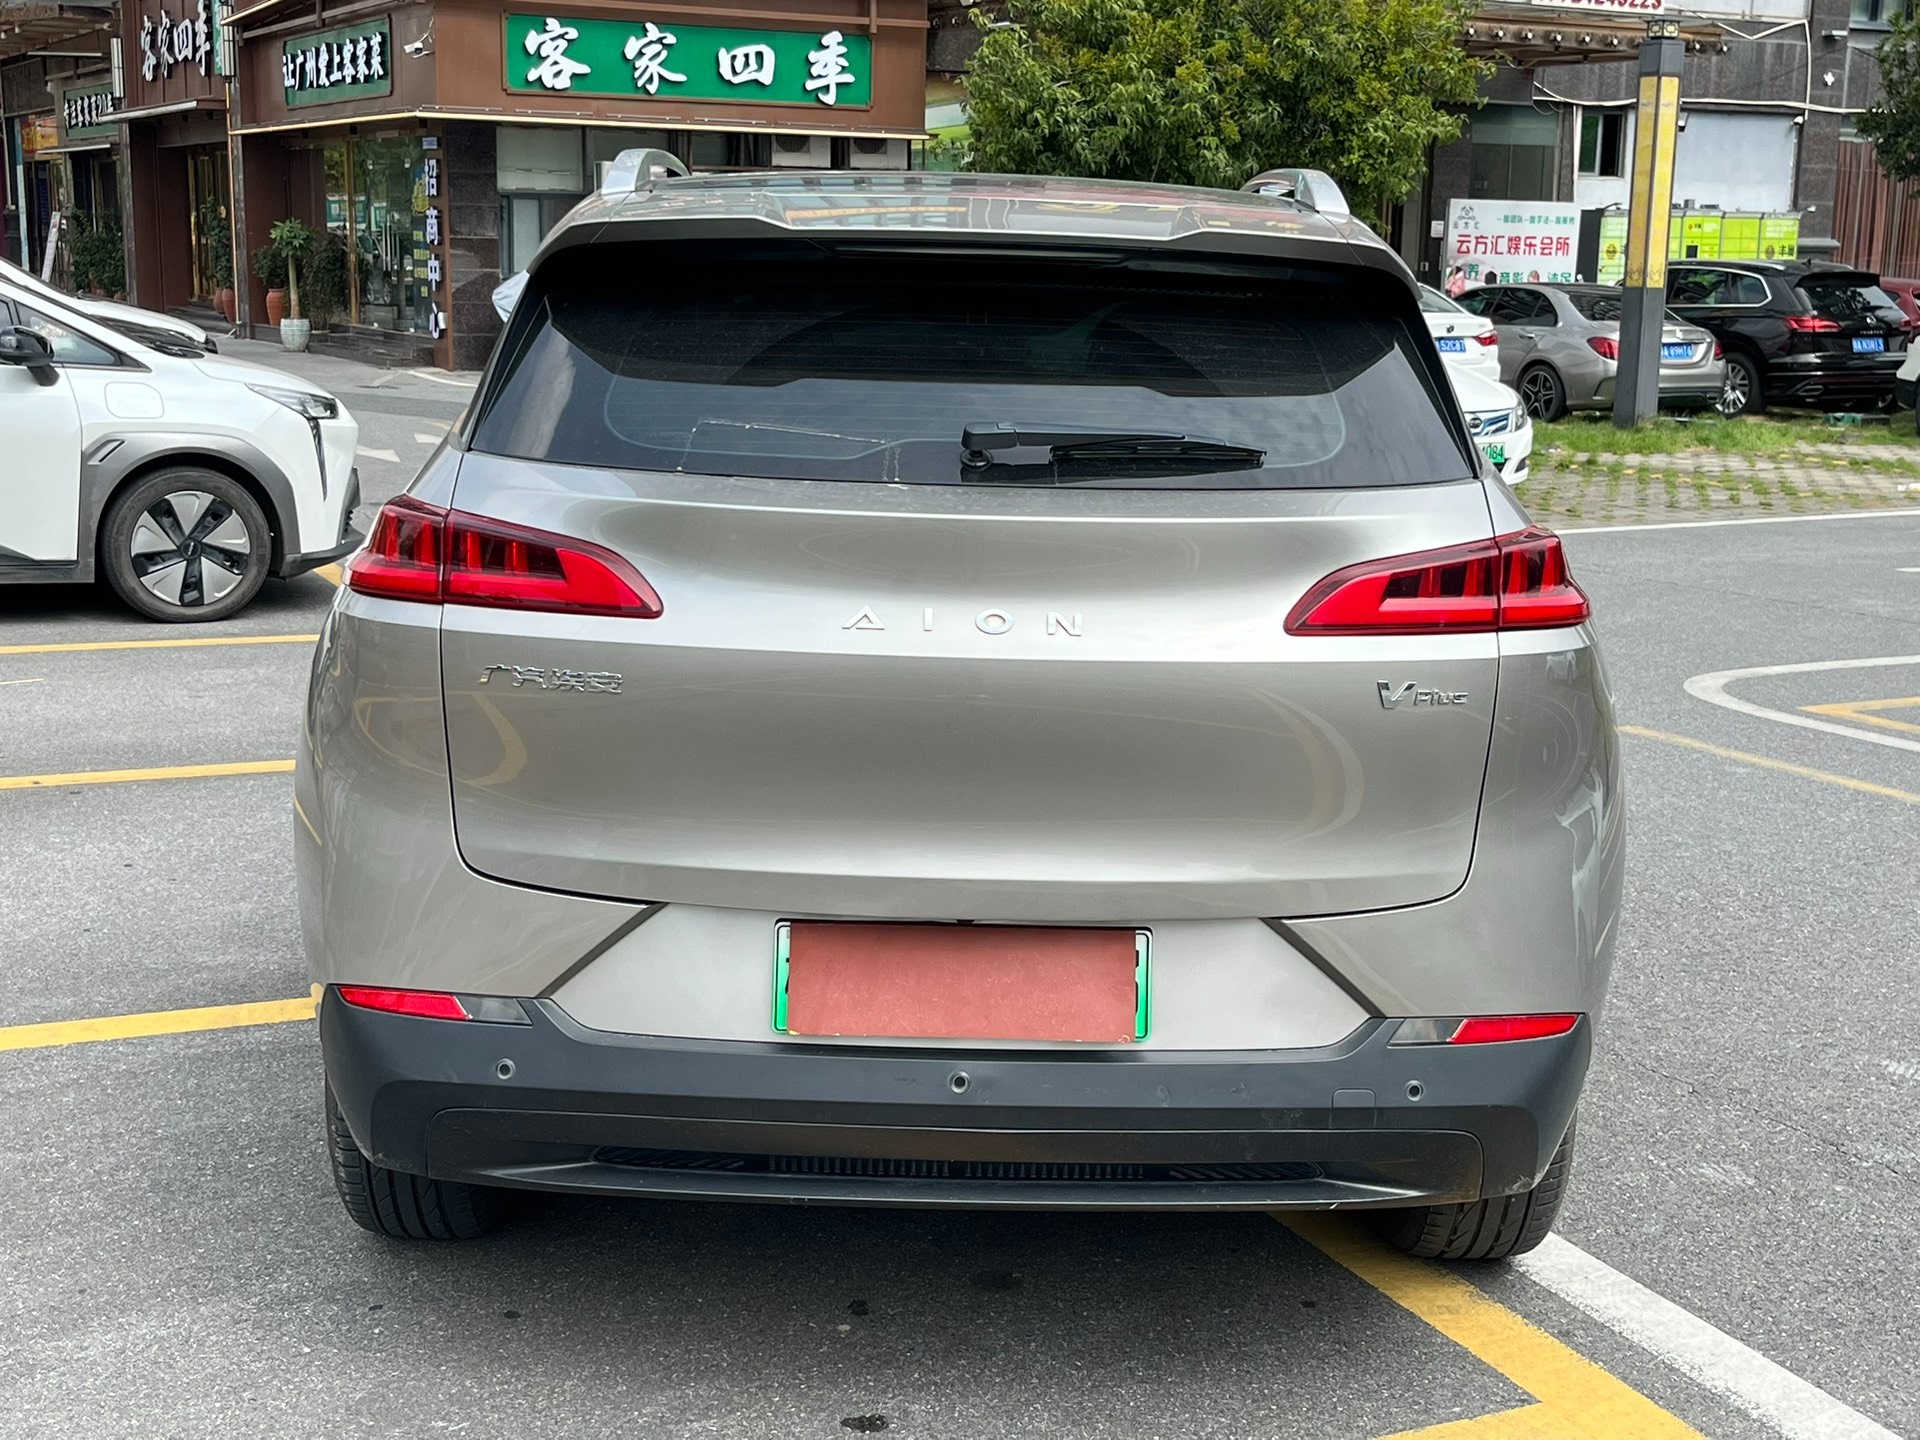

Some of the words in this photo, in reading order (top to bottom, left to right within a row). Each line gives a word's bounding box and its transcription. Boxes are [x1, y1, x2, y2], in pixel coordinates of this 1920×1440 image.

[141, 0, 211, 82] 客家四季
[283, 32, 384, 91] 让广州爱上客家菜
[524, 17, 856, 106] 客家四季
[425, 158, 441, 340] 招商中心
[1456, 234, 1570, 256] 云方汇娱乐会所
[842, 605, 1083, 637] AION
[478, 664, 623, 694] 广汽埃安
[1377, 680, 1417, 709] V
[1413, 690, 1468, 705] Plus
